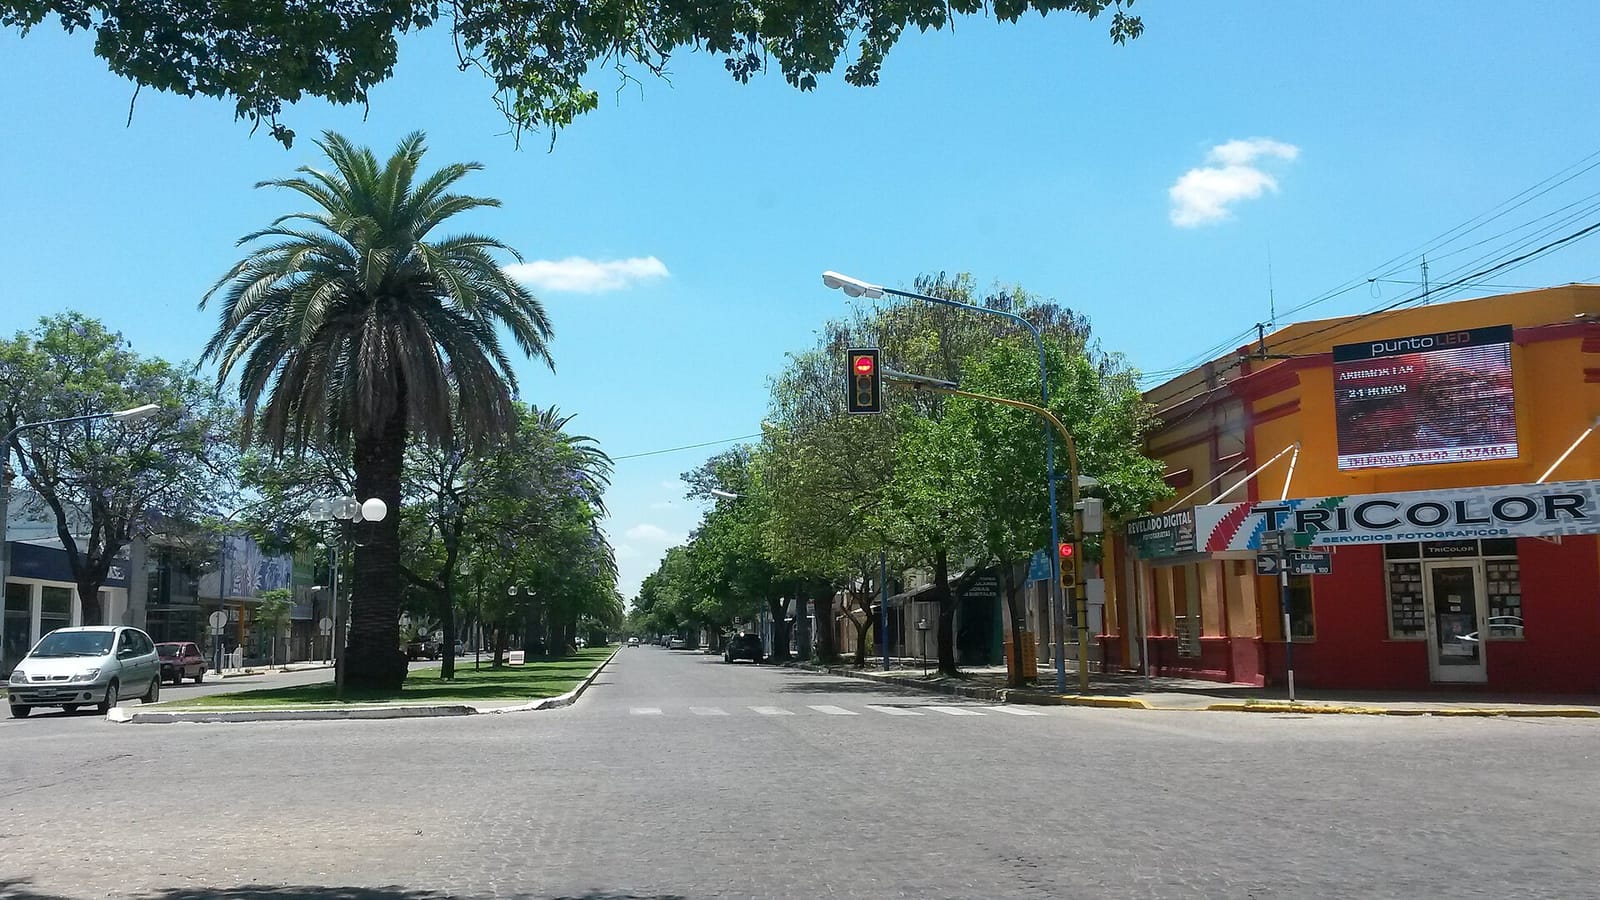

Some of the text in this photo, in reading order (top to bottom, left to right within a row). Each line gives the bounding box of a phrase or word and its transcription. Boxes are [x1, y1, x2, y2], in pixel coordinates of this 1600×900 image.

[1367, 384, 1407, 397] HORAS
[1128, 511, 1192, 535] REVELADO DIGITAL
[1322, 528, 1509, 544] SERVICIOS FOTOGRAFICOS
